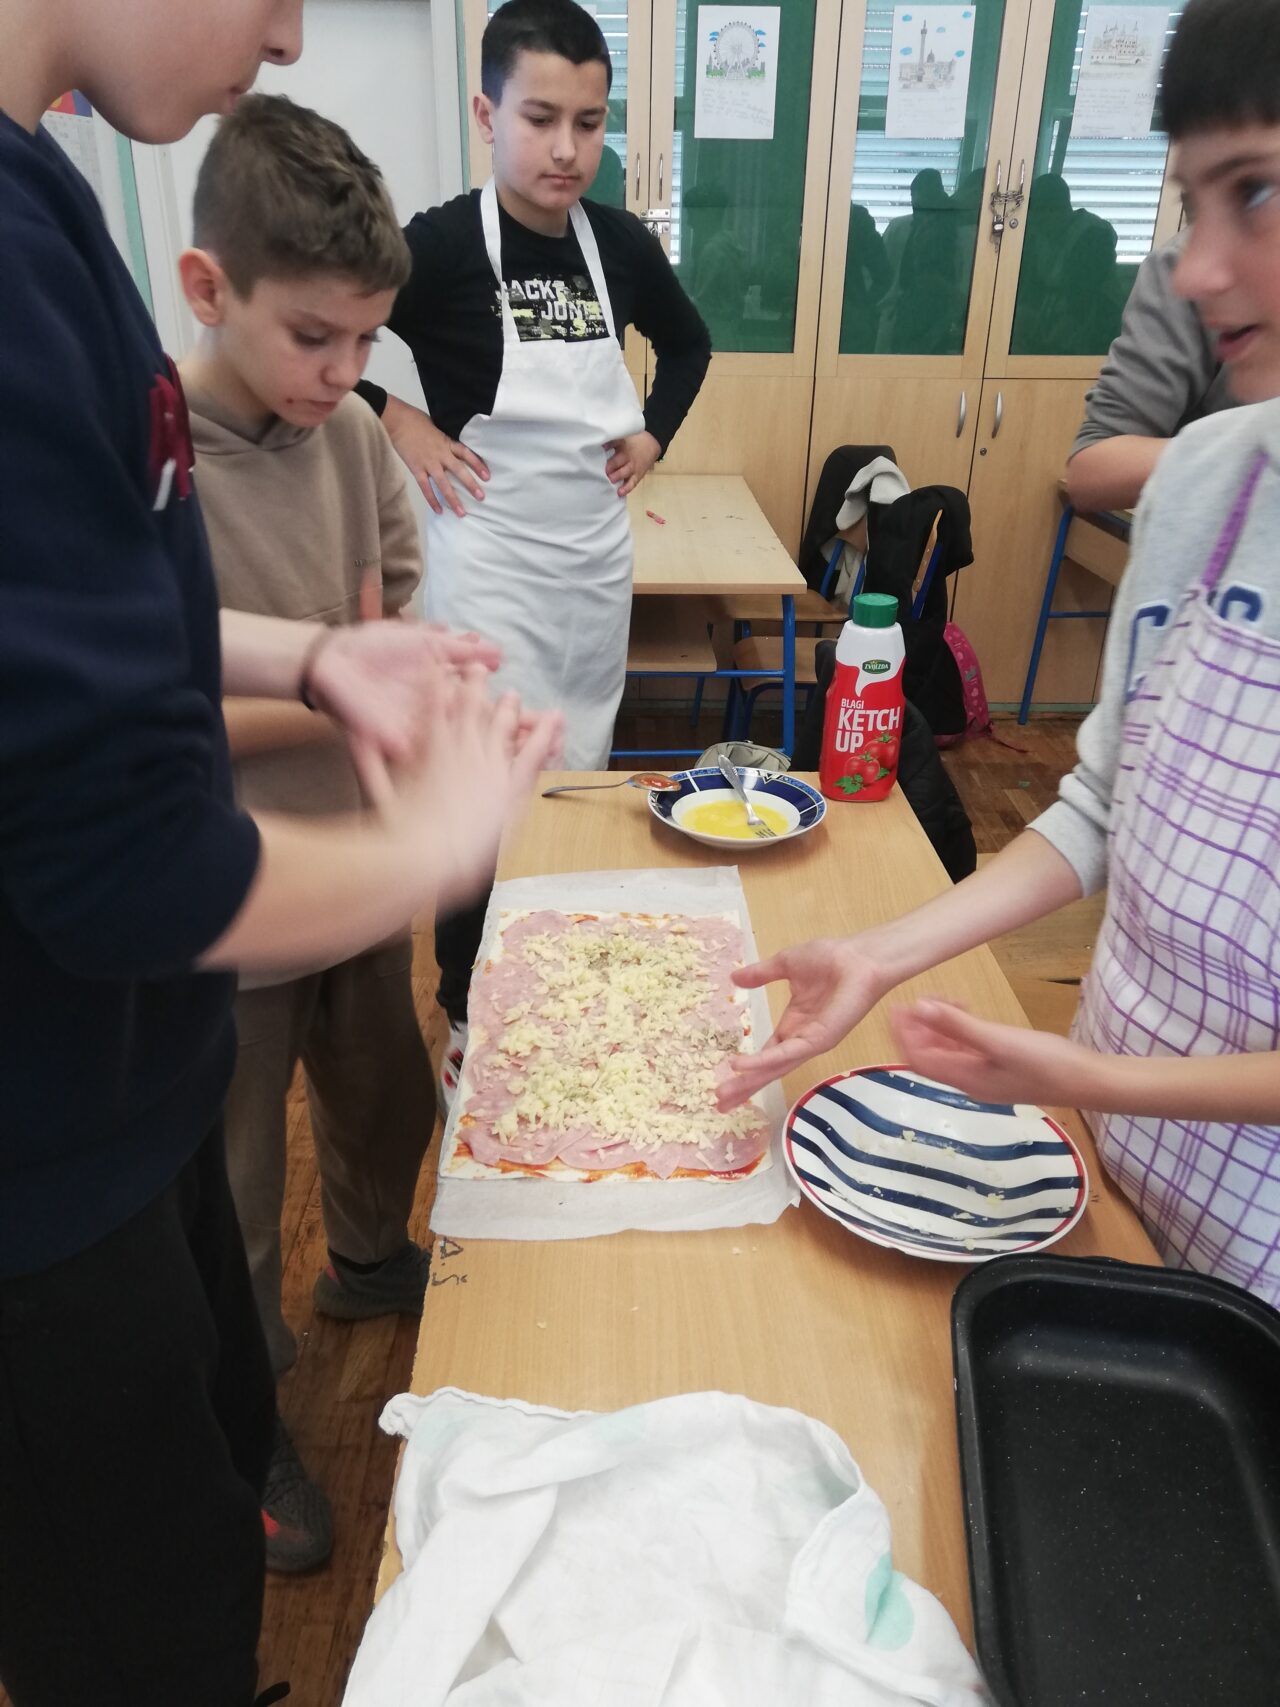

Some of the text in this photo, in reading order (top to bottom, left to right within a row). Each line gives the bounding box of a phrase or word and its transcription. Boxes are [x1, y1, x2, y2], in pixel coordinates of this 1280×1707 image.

[841, 698, 864, 709] BLAGI
[838, 706, 900, 731] KETCH
[836, 730, 863, 753] UP
